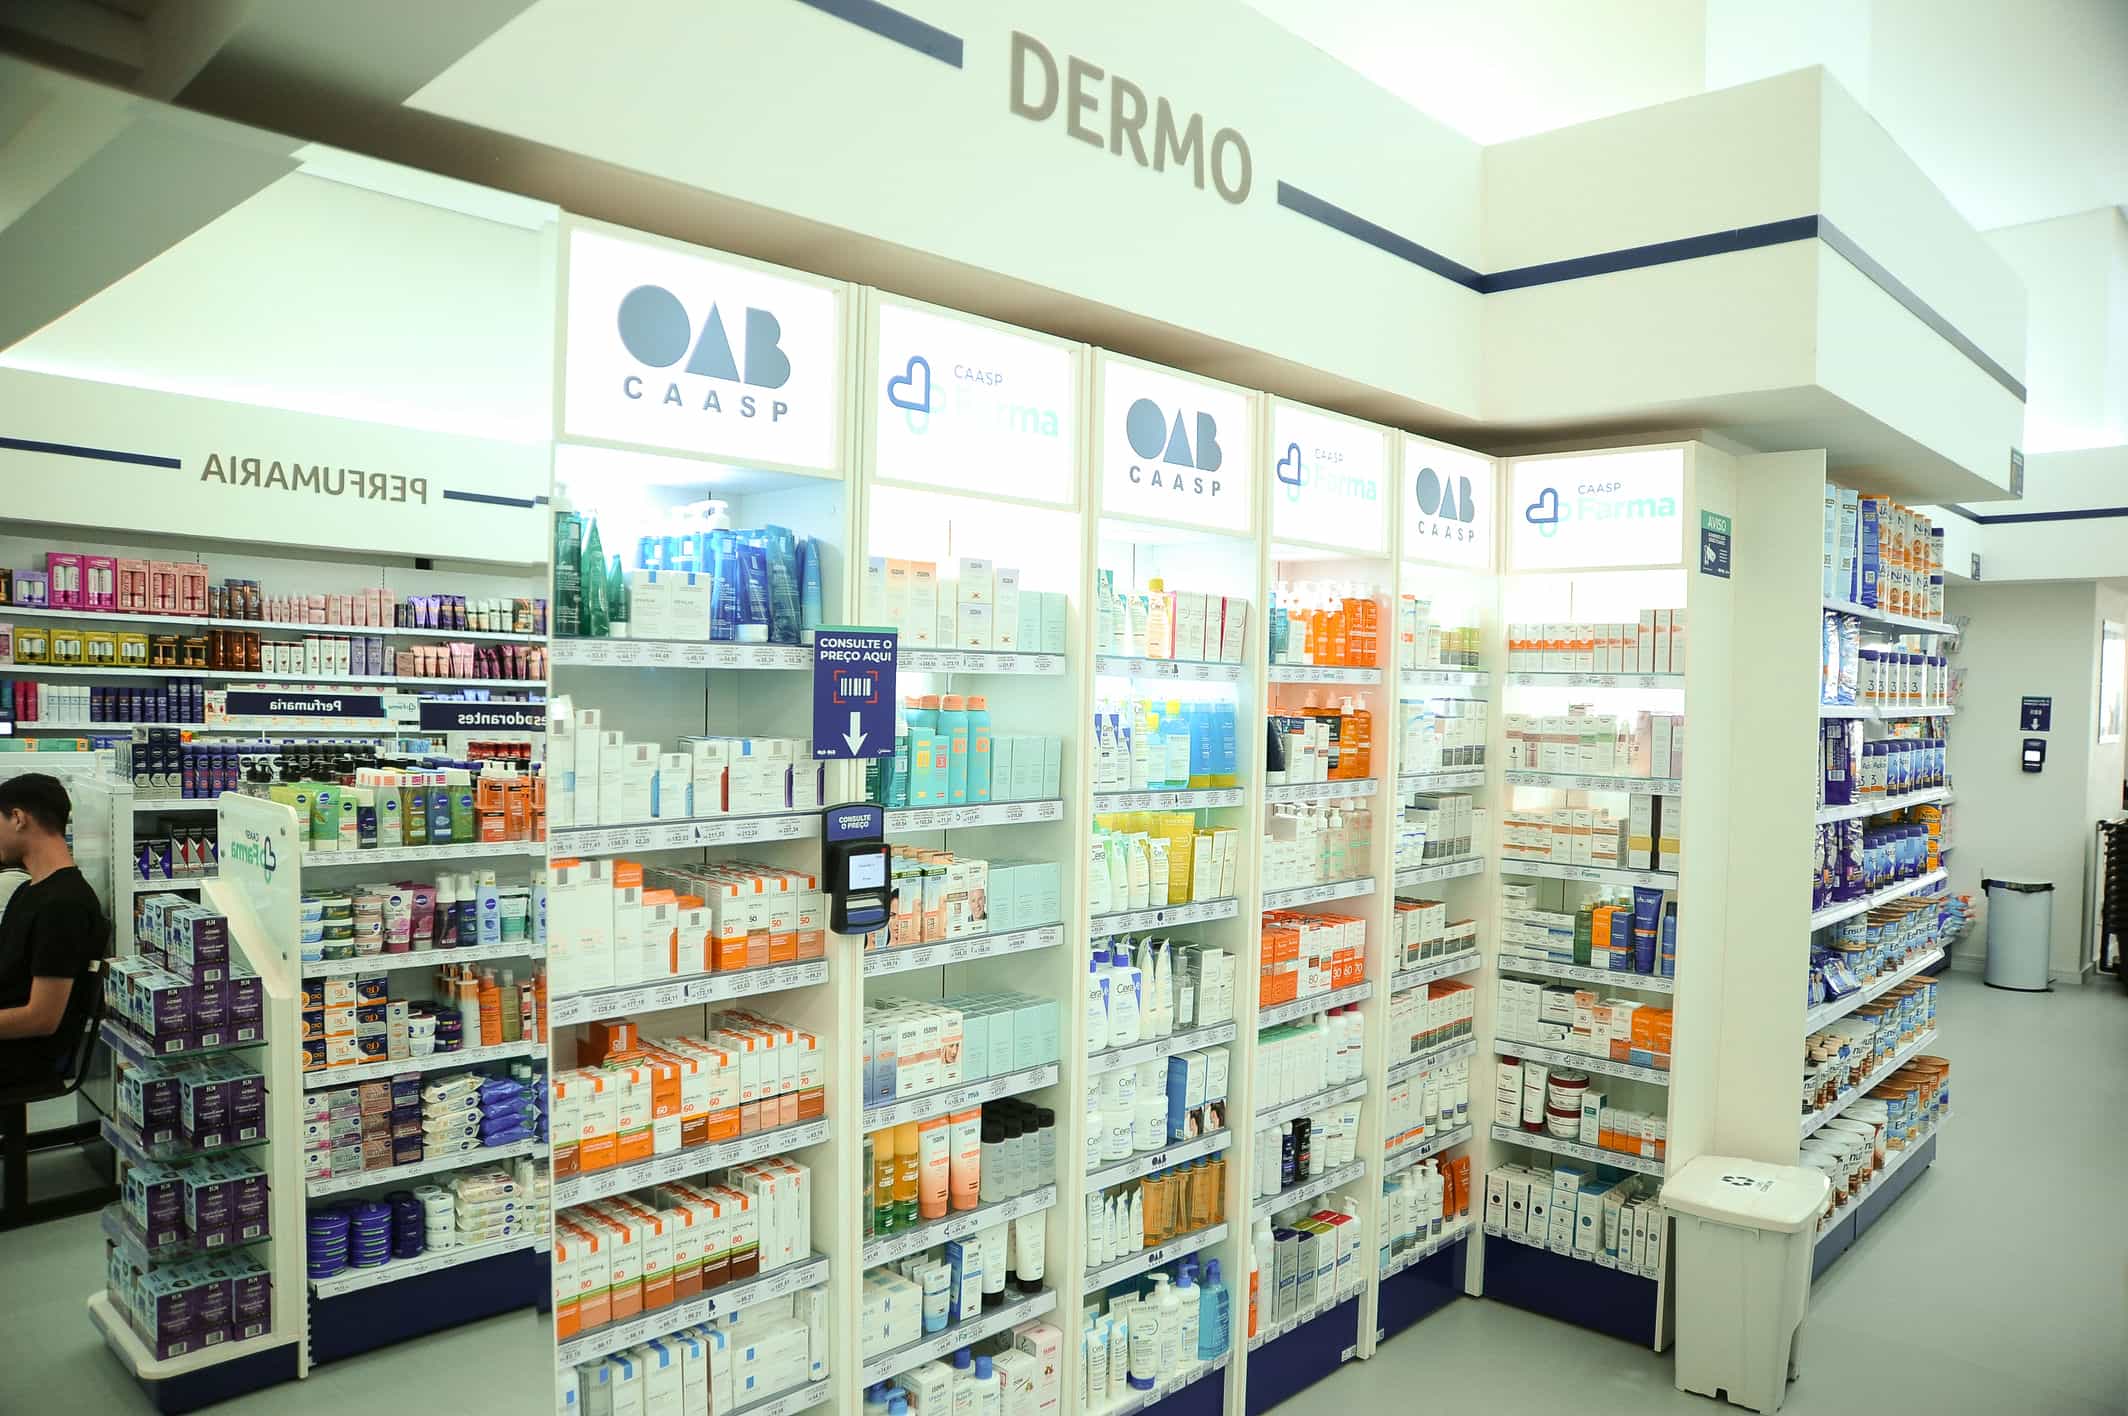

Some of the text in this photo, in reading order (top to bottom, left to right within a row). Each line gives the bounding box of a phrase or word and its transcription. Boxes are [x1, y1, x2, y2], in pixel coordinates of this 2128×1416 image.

[1010, 30, 1252, 205] DERMO
[617, 284, 791, 389] OAB
[953, 363, 1004, 387] CAASP
[623, 374, 788, 423] CAASP
[1126, 398, 1222, 472] OAB
[1314, 447, 1344, 463] CAASP
[1130, 465, 1221, 497] CAASP
[1578, 482, 1621, 495] CAASP
[1416, 467, 1475, 523] OAB
[1577, 495, 1676, 521] Farma
[1418, 521, 1475, 543] CAASP
[1708, 516, 1727, 532] AVISO
[820, 638, 893, 650] CONSULTE O
[820, 650, 861, 664] PREÇO
[862, 650, 892, 662] AQUI
[838, 814, 872, 823] CONSULTE
[840, 820, 870, 830] O PREÇO
